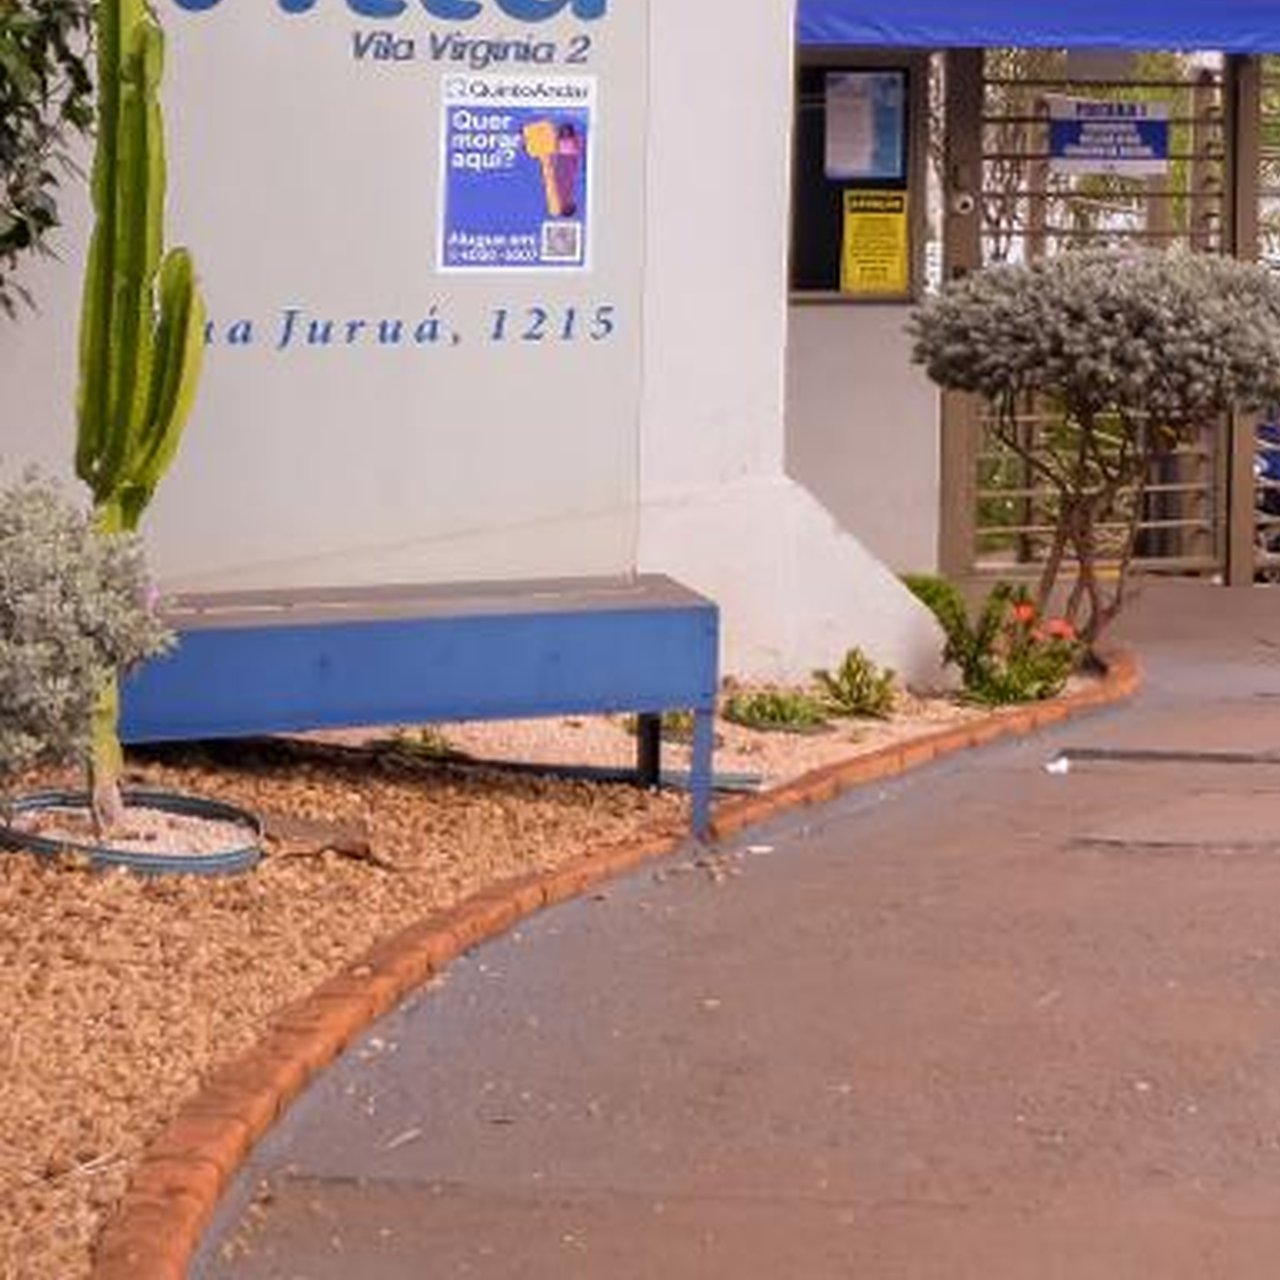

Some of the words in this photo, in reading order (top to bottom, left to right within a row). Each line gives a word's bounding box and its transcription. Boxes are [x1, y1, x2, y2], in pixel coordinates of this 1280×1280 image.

[352, 31, 415, 61] Vila
[565, 34, 591, 64] 2
[452, 110, 513, 130] Quer
[452, 150, 515, 170] aqui?
[490, 305, 616, 342] 1215
